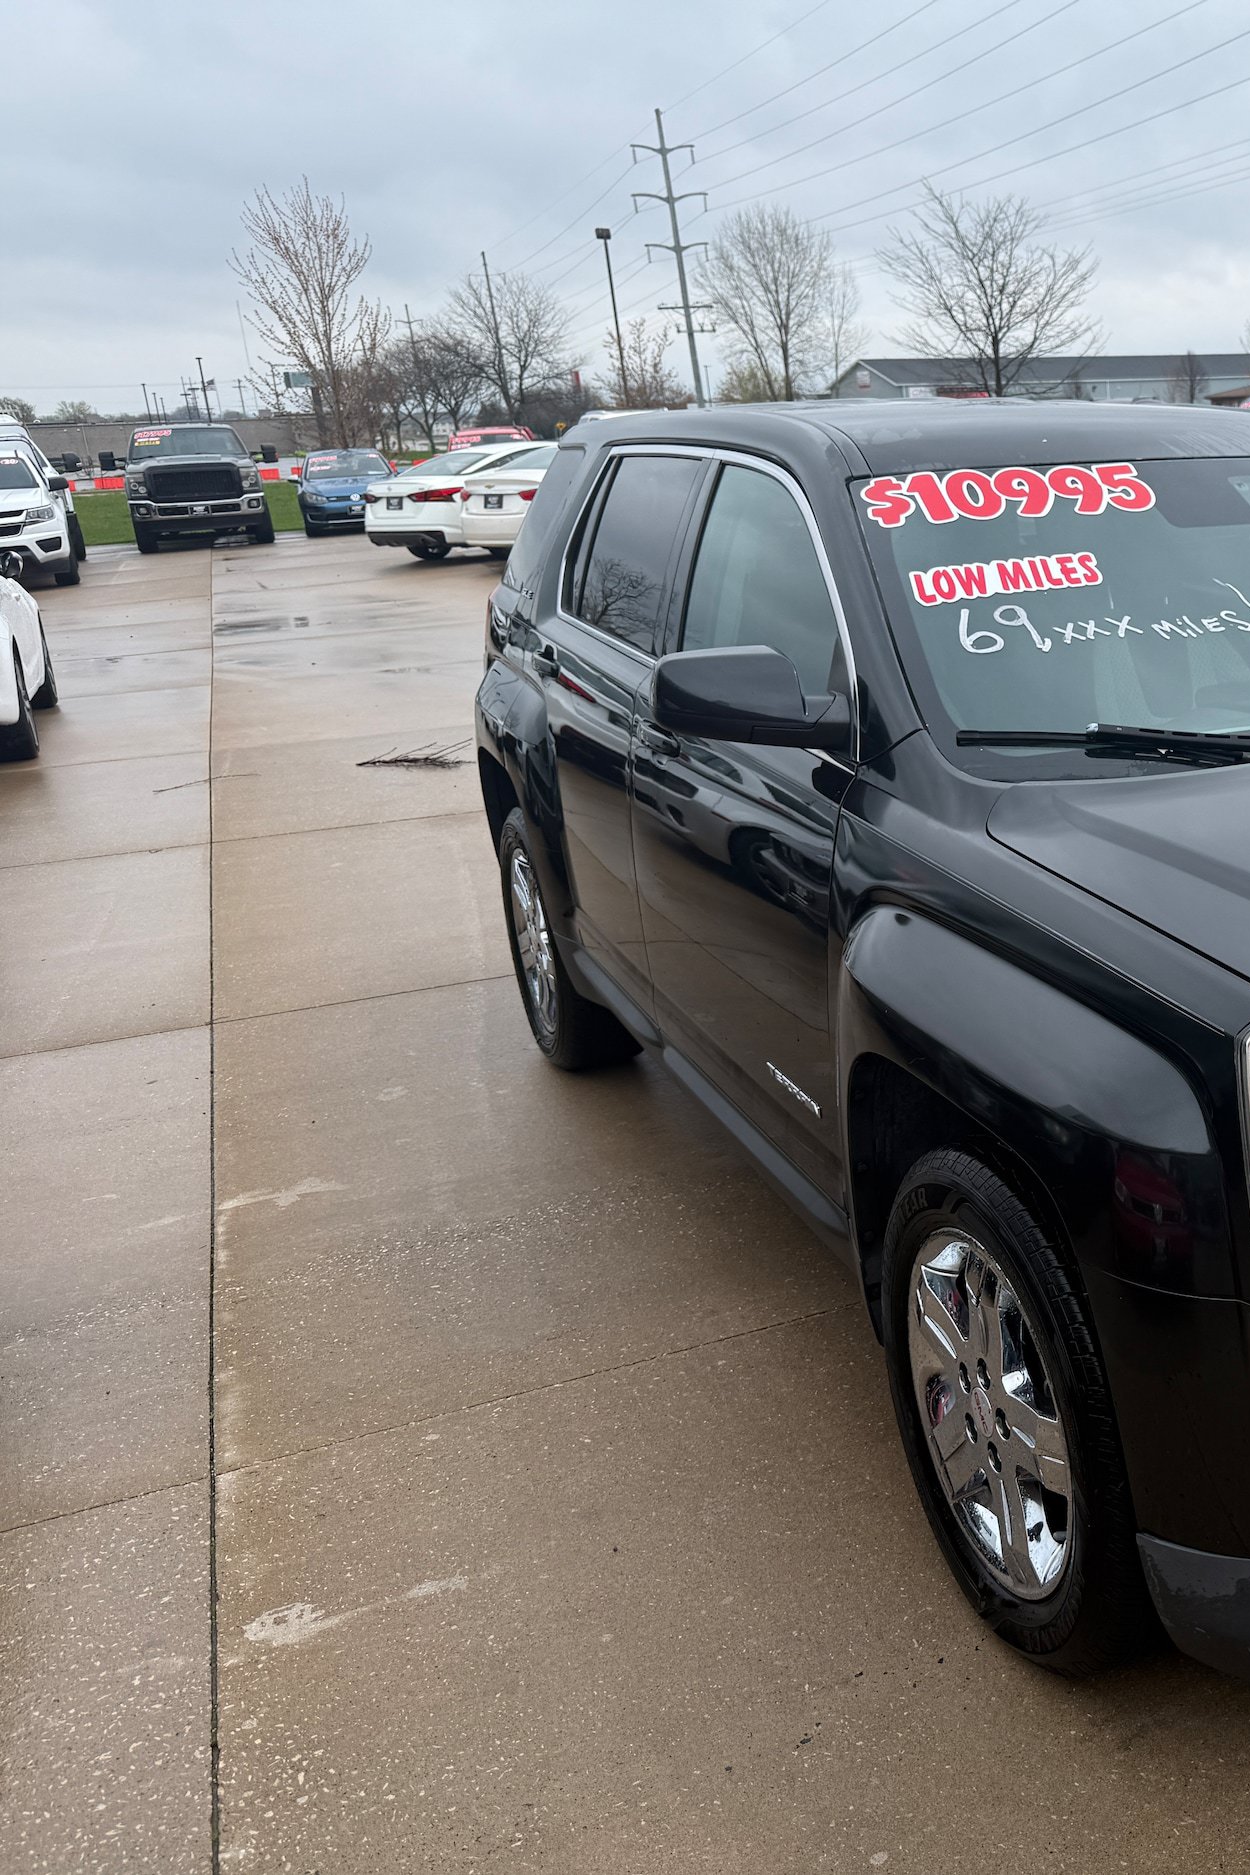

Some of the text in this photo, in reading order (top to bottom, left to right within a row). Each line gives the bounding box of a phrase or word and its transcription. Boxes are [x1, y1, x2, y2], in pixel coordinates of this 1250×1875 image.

[861, 463, 1156, 527] $10995
[911, 552, 1102, 605] LOW MILES
